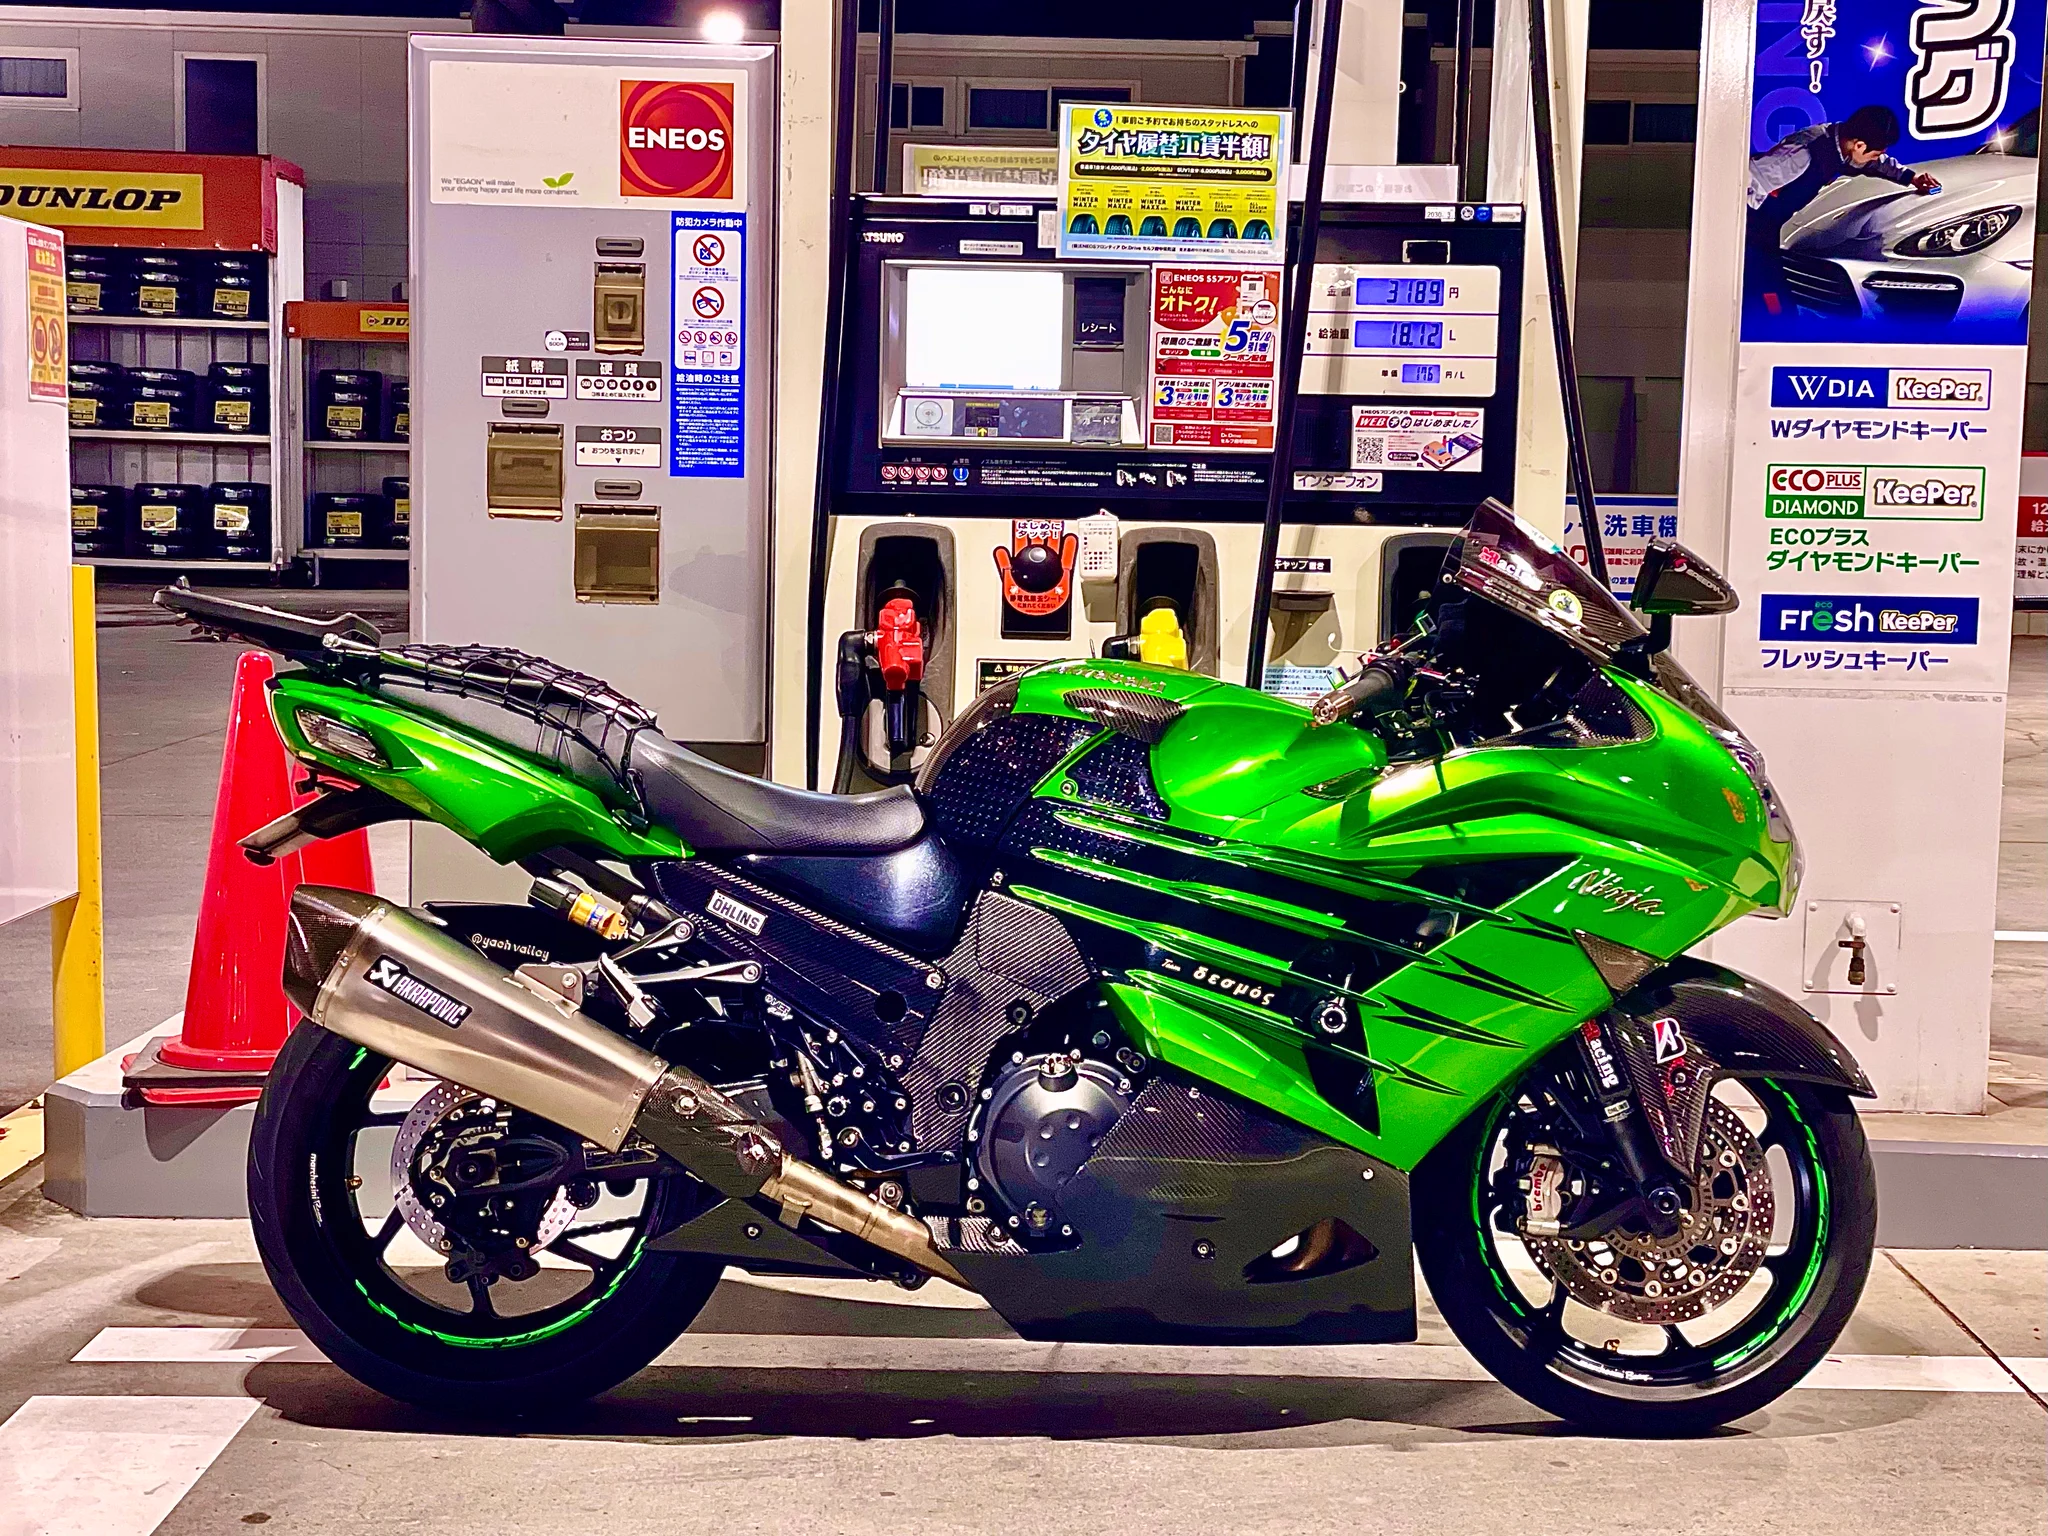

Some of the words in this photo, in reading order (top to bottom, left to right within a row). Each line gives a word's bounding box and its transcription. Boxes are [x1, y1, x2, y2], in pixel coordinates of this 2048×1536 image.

[628, 127, 725, 151] ENEOS
[1079, 129, 1270, 158] タイヤ履替工賃半額!
[457, 186, 478, 194] driving
[480, 186, 499, 195] happy
[675, 217, 743, 228] 防犯カメラ作動中
[863, 232, 904, 244] TSUNO
[1173, 274, 1205, 283] ENEOS
[1160, 285, 1194, 295] こんなに
[1386, 280, 1441, 304] 3189
[1449, 287, 1459, 299] 円
[1160, 296, 1219, 315] オトク!
[1080, 322, 1117, 334] レシート
[1224, 320, 1251, 352] 5
[1318, 328, 1350, 340] 給油量
[1391, 323, 1440, 347] 18.12
[1449, 330, 1457, 341] L
[505, 359, 545, 373] 紙幣
[599, 362, 639, 376] 硬貨
[675, 373, 740, 384] 給油時のご注意
[1159, 386, 1175, 405] 3
[1218, 387, 1234, 407] 3
[1896, 377, 1981, 402] KeePer
[1359, 417, 1386, 427] WEB
[1770, 418, 1988, 441] Wダイヤモンドキーパー
[600, 429, 637, 442] おつり
[1298, 474, 1379, 489] インターフォン
[1772, 469, 1825, 491] ECO
[1826, 474, 1862, 488] PLUS
[1873, 477, 1975, 507] KeePer
[1772, 499, 1859, 516] DIAMOND
[1018, 522, 1061, 530] はじめに
[1769, 528, 1870, 547] ECOプラス
[1765, 550, 1980, 573] ダイヤモンドキーパー
[1779, 602, 1874, 633] Fresh
[1879, 609, 1958, 634] KeePer
[1760, 649, 1949, 671] フレッシュキーパー
[1566, 868, 1666, 916] Ninja
